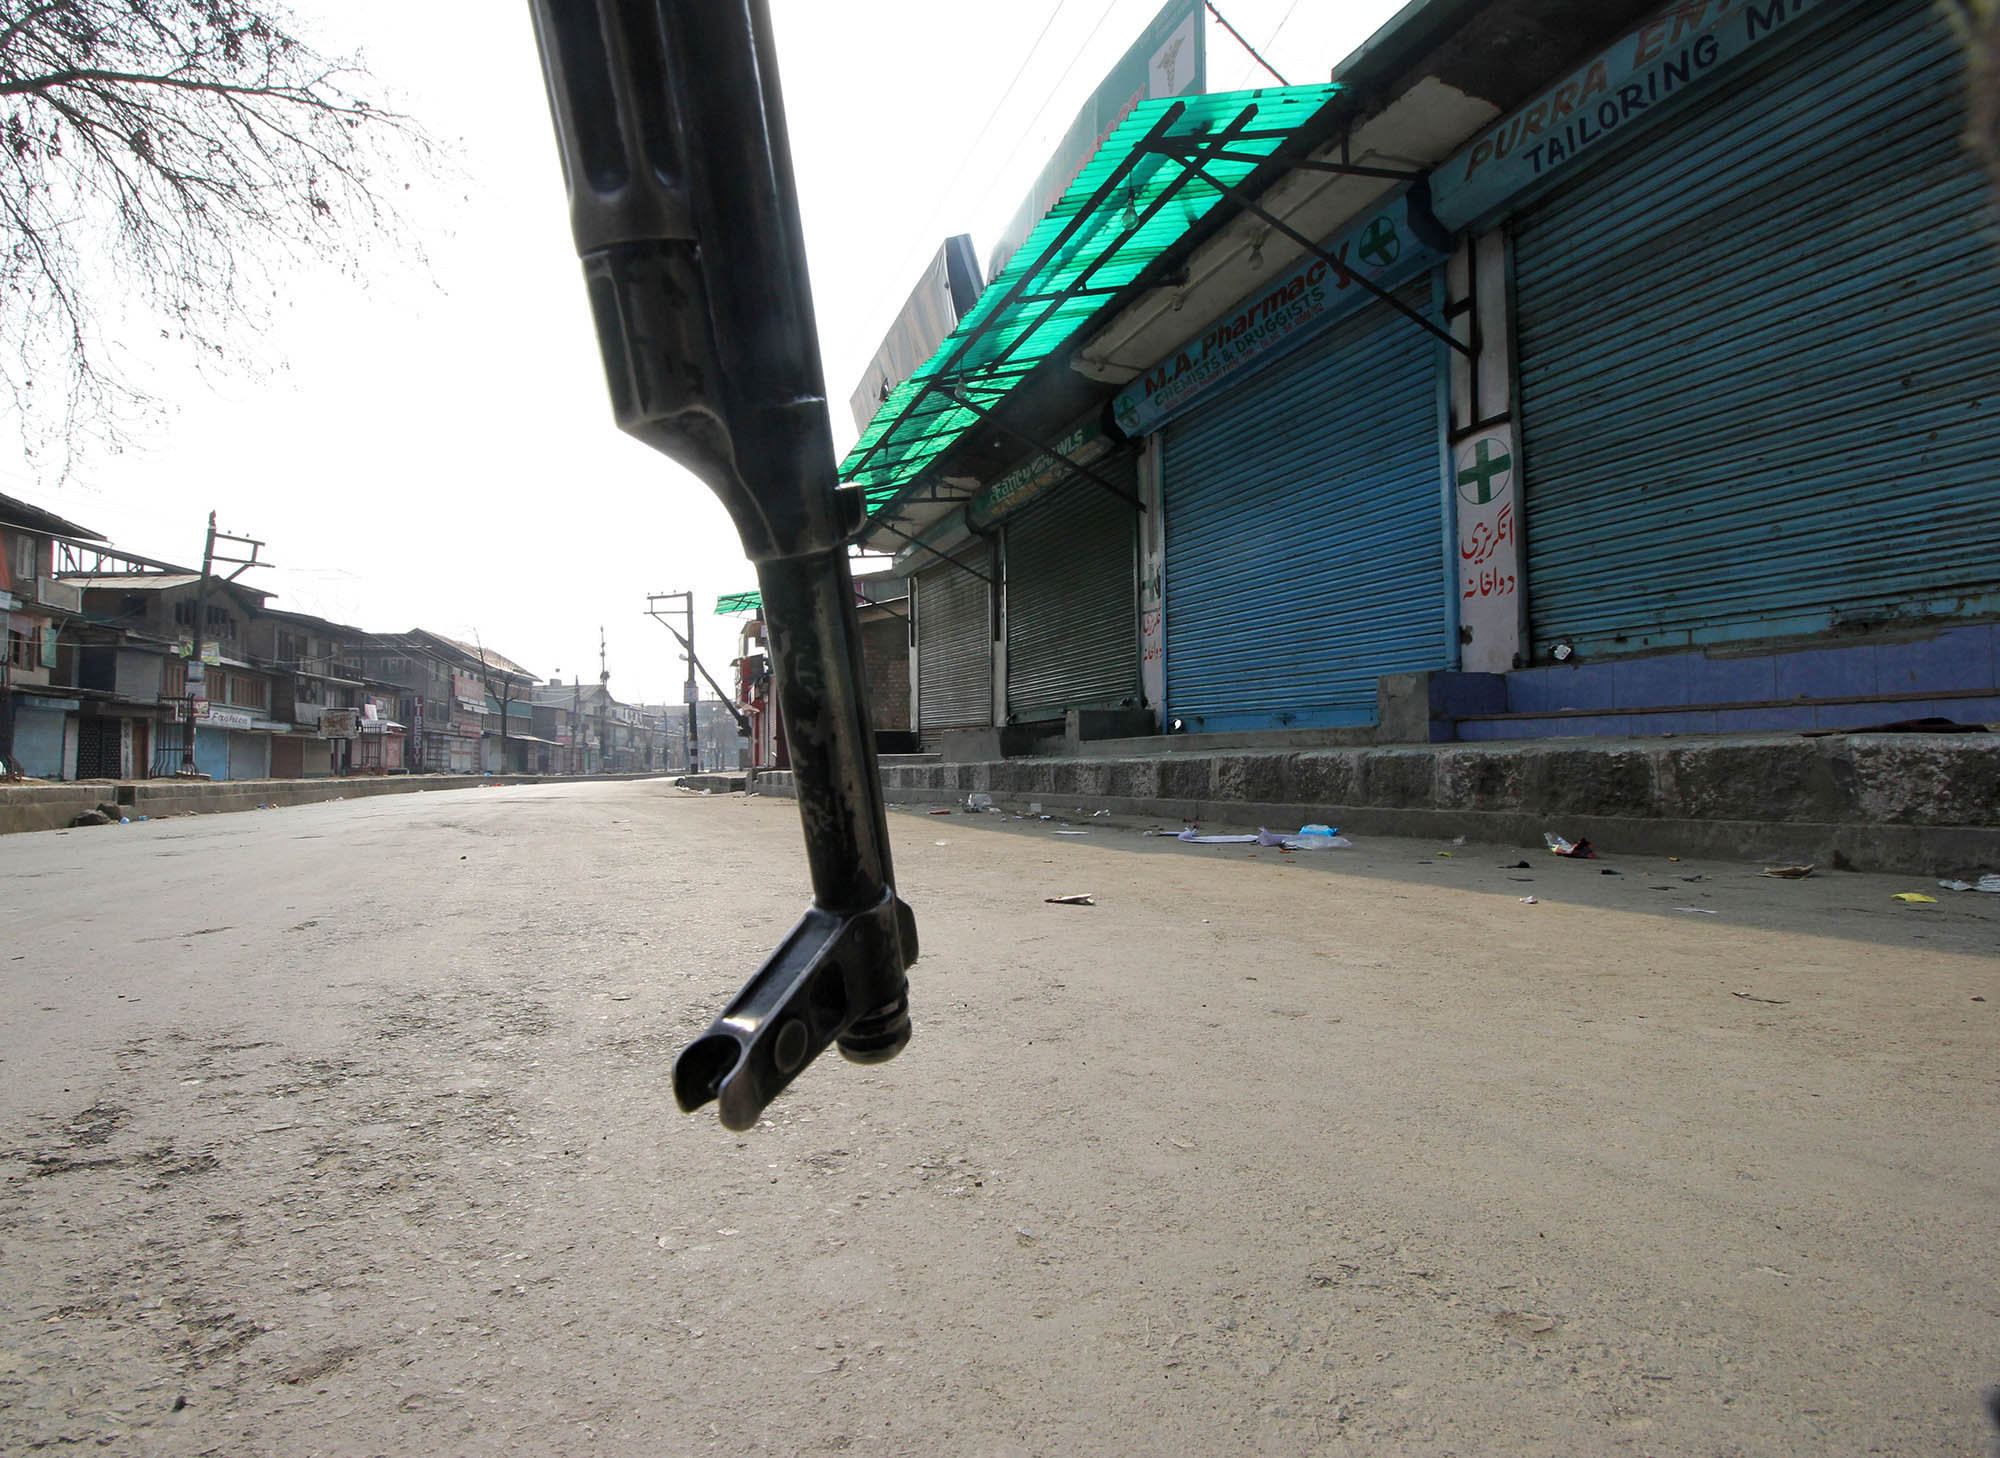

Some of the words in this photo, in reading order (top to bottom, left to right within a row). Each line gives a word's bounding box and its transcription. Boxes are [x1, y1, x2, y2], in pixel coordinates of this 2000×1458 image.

[1464, 59, 1607, 183] PURRA
[1522, 35, 1720, 173] TAILORING
[1746, 0, 1803, 41] M
[1144, 352, 1199, 397] M.A.
[1201, 240, 1352, 359] Pharmacy
[1154, 355, 1221, 406] CHEMISTS
[1222, 350, 1233, 362] &
[1235, 287, 1325, 353] DRUGGISTS
[1461, 502, 1513, 564] انگریزی
[1463, 566, 1515, 600] دواخانہ
[413, 696, 423, 765] LIBERTY
